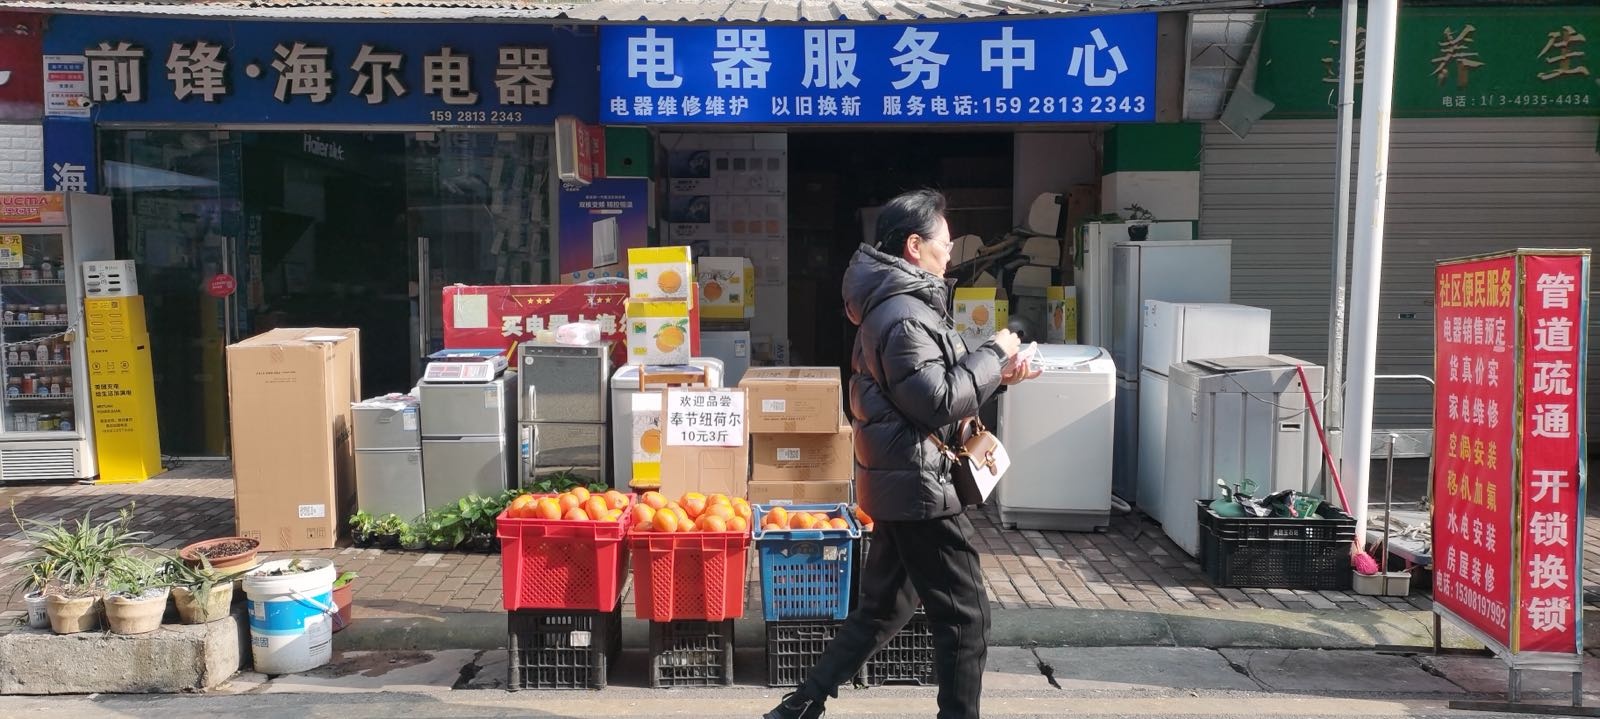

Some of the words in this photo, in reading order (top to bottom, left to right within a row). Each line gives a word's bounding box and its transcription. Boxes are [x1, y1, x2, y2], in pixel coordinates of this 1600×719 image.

[84, 41, 554, 105] 前锋·海尔电器
[628, 26, 1129, 89] 电器服务中心
[430, 110, 452, 121] 159
[457, 111, 486, 122] 2813
[490, 111, 522, 122] 2343
[610, 95, 749, 117] 电器维修维护
[771, 95, 862, 117] 以旧换新
[1028, 96, 1083, 114] 2813
[1090, 96, 1146, 113] 2343
[0, 196, 48, 206] UCMA
[1439, 267, 1512, 308] 社区便民服务
[1443, 316, 1506, 349] 电器销售预定
[1449, 354, 1499, 387] 货真价实
[1531, 272, 1575, 438] 管道疏通
[680, 395, 732, 407] 欢迎品尝
[1448, 394, 1499, 428] 家电维修
[670, 412, 741, 427] 奉节纽荷尔
[681, 430, 728, 442] 10元3斤
[1448, 432, 1496, 470] 空调安装
[1447, 508, 1496, 552] 水电安装
[1528, 470, 1571, 632] 开锁换锁
[1446, 545, 1495, 592] 房屋装修
